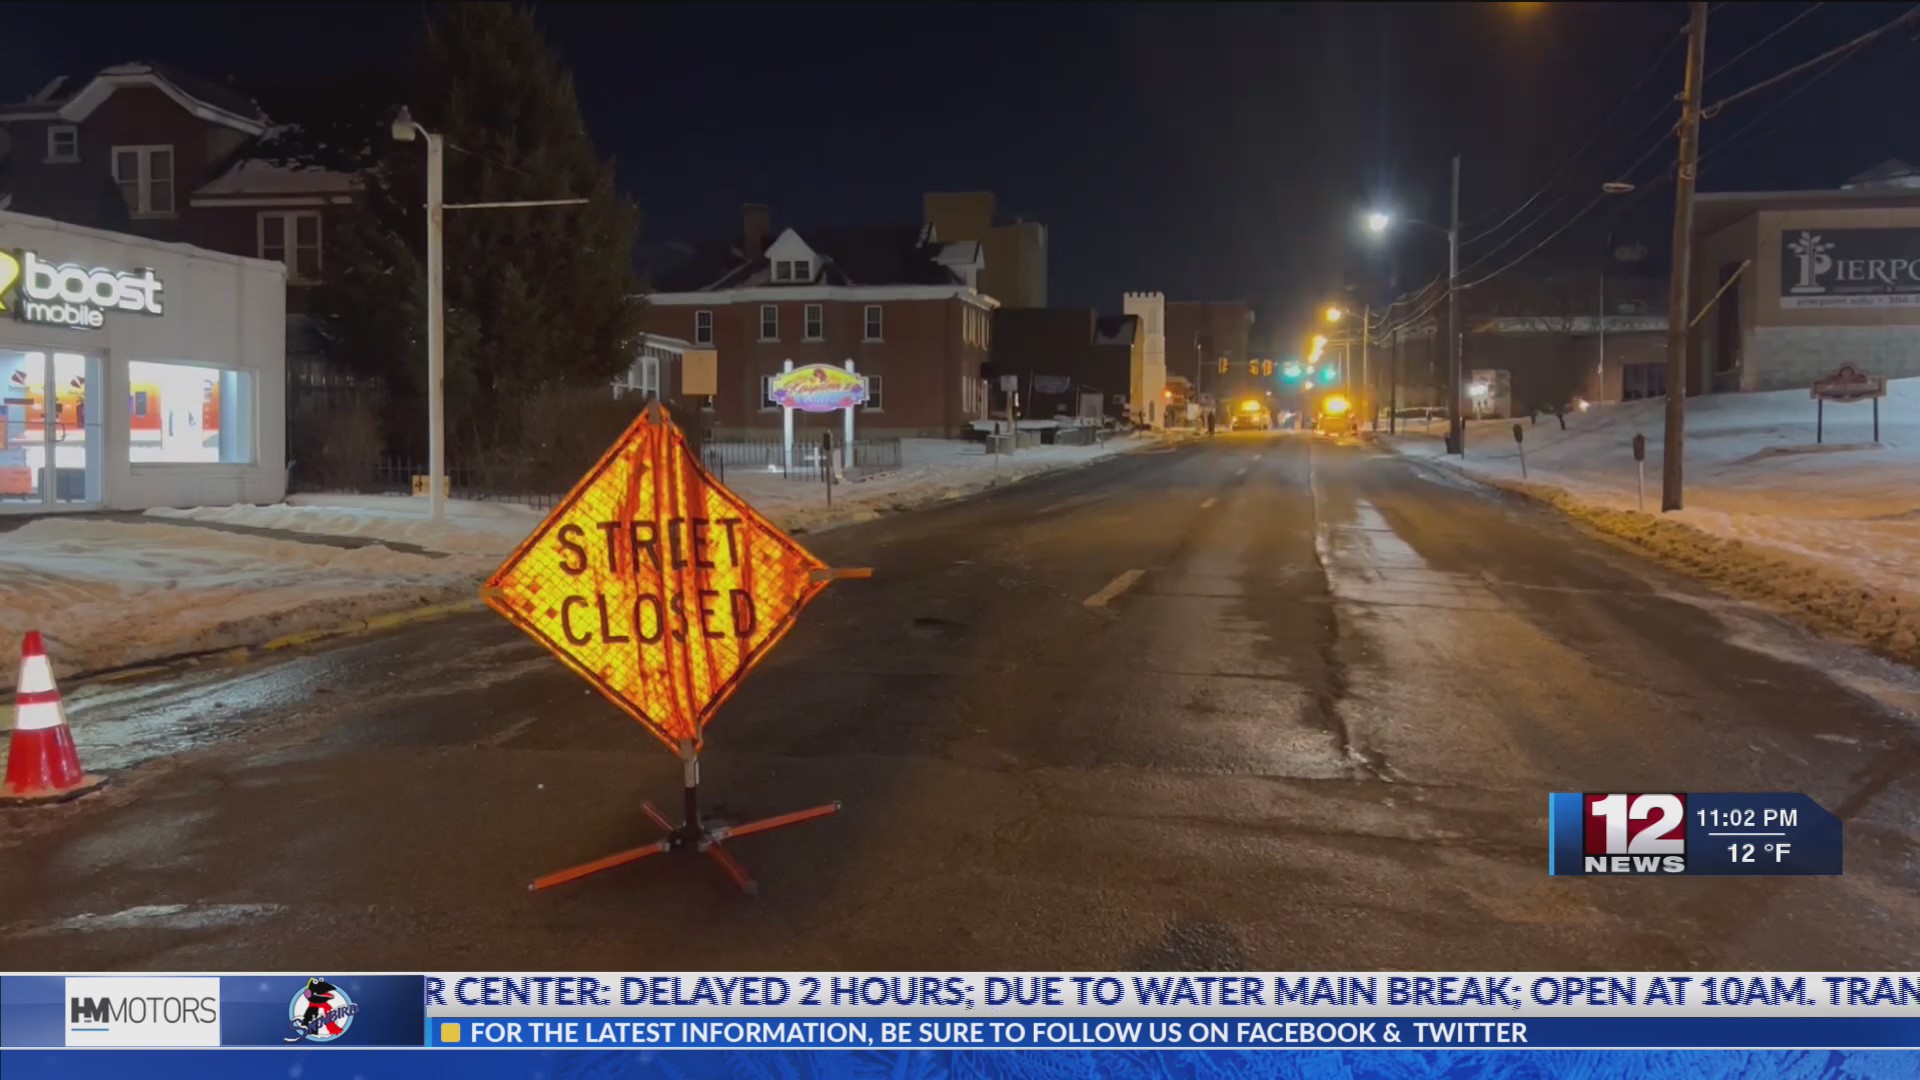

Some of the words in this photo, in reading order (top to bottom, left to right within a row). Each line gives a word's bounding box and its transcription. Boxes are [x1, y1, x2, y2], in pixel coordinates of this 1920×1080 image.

[24, 251, 163, 315] boost
[24, 299, 104, 328] mobile
[560, 588, 758, 647] CLOSED
